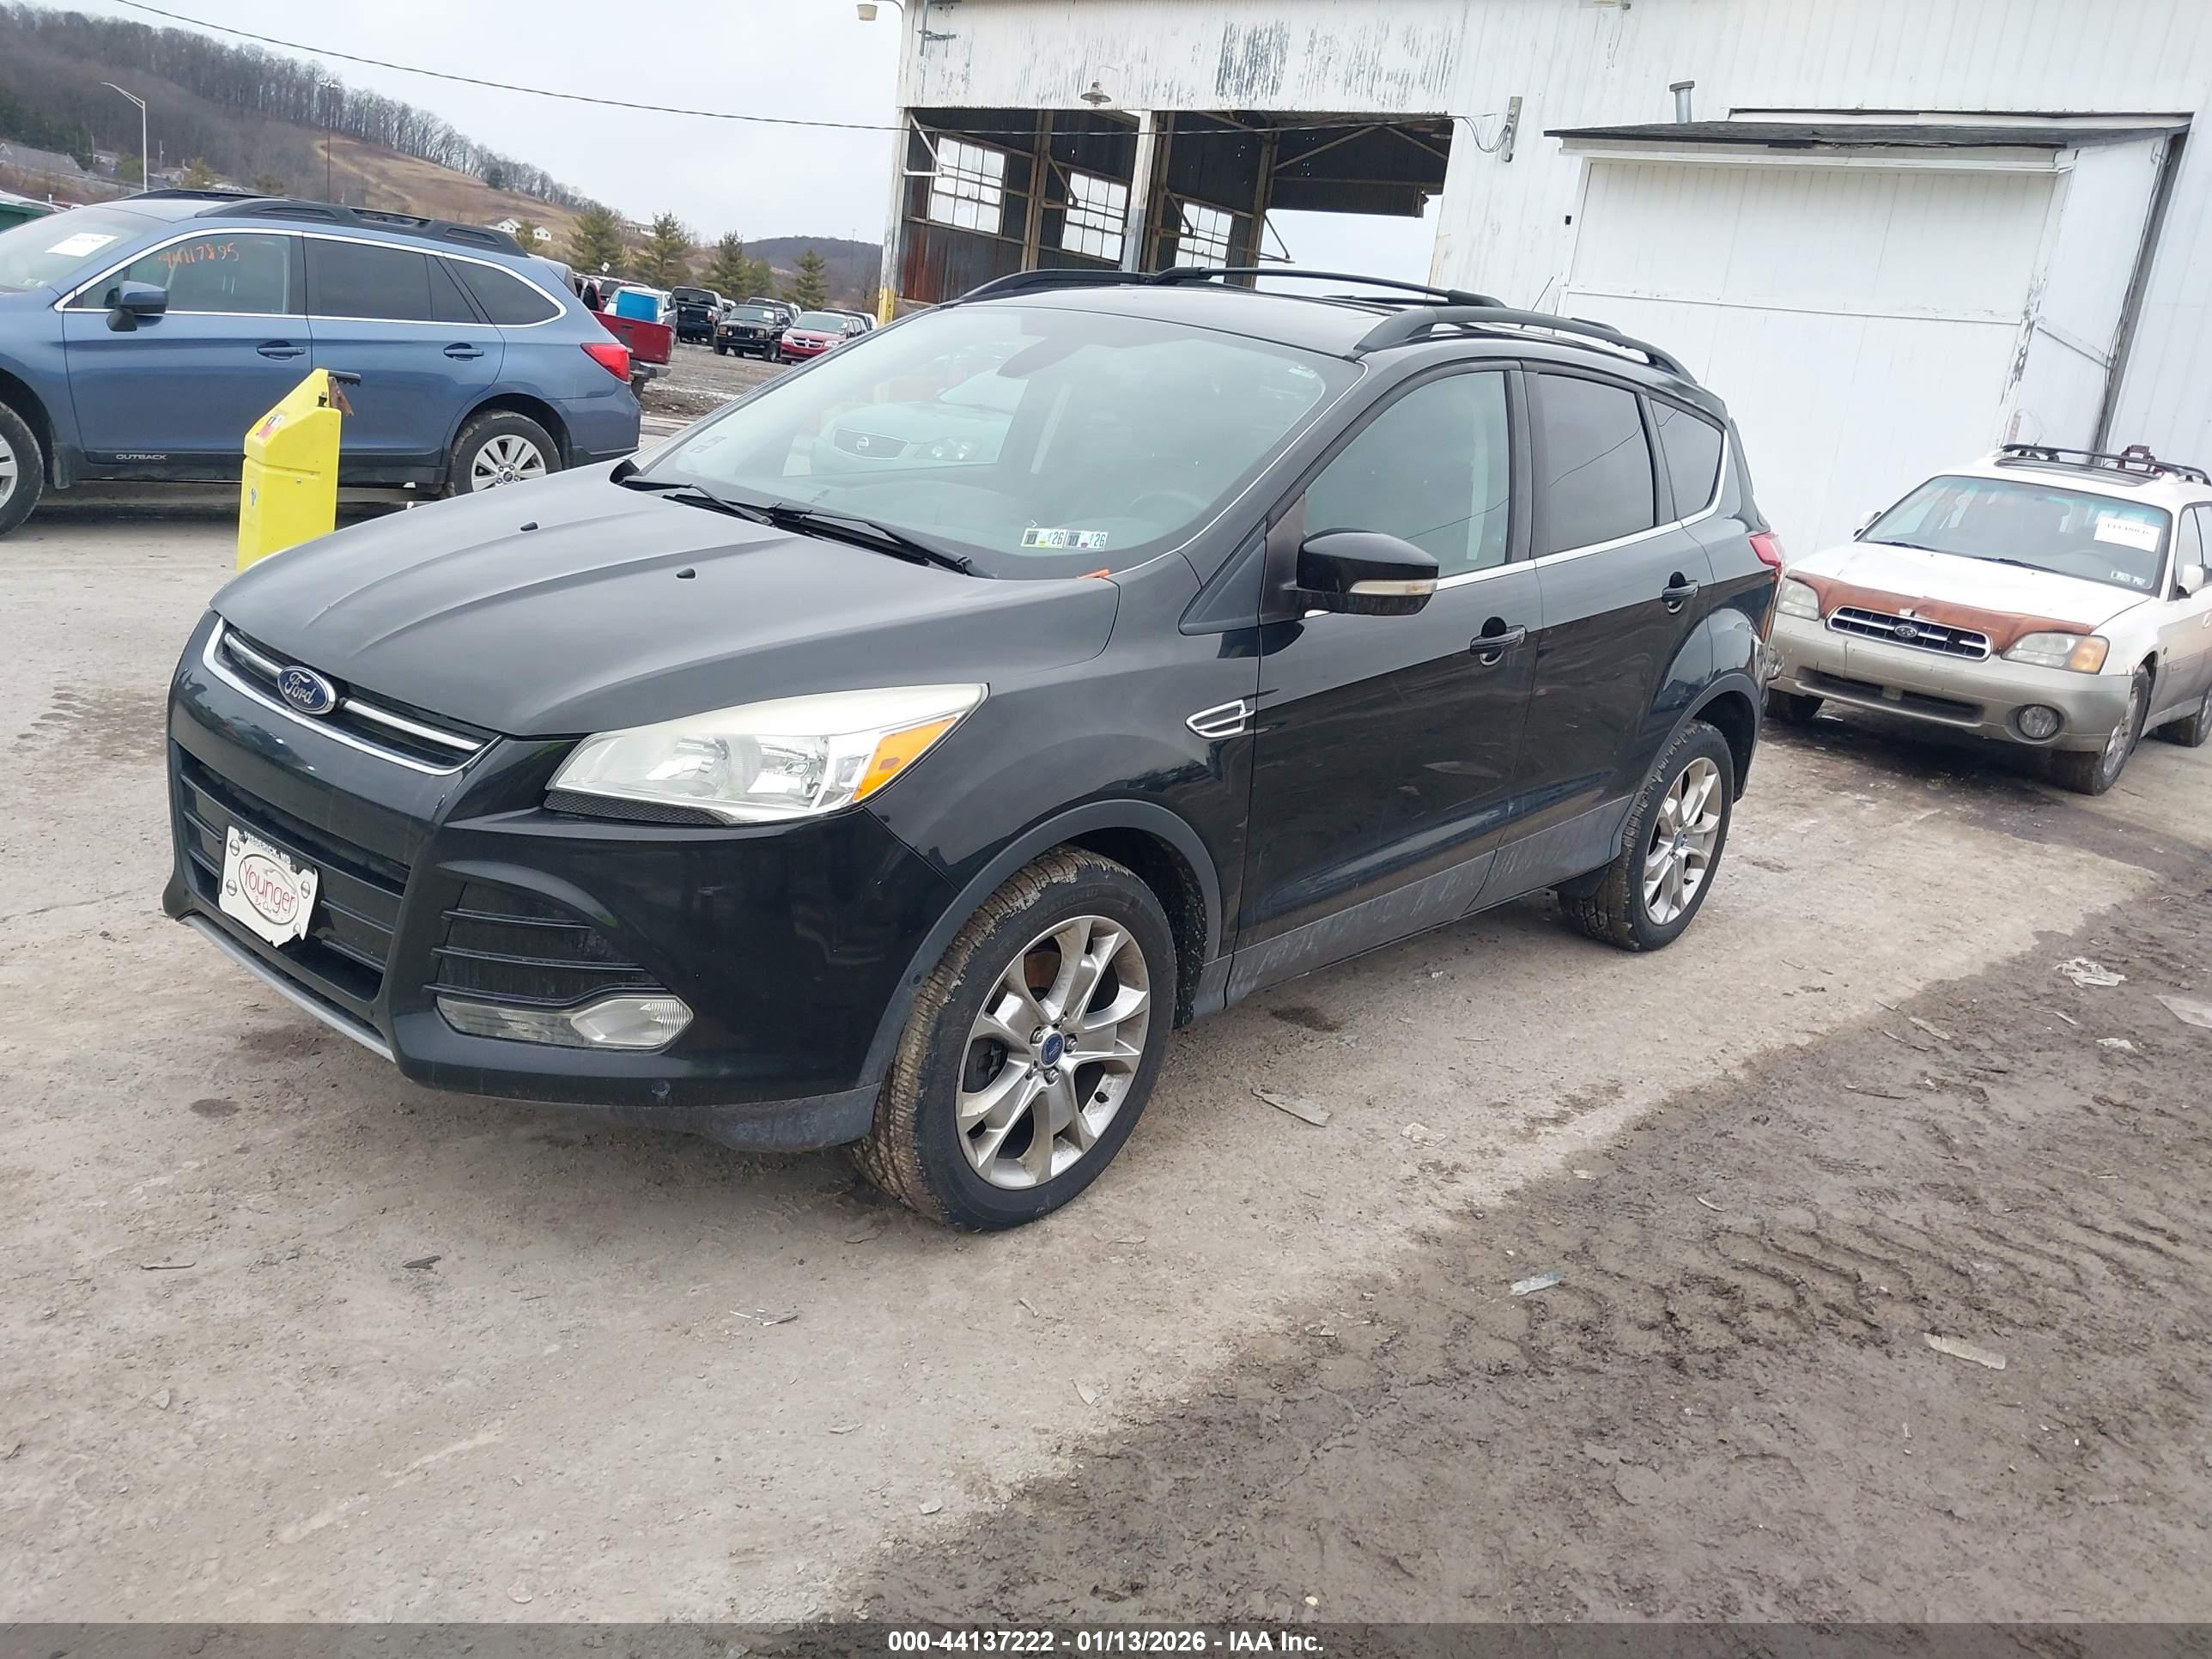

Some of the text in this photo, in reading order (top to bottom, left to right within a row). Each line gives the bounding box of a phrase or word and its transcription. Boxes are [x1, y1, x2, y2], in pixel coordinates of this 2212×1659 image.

[1052, 532, 1064, 544] 26
[1094, 533, 1105, 547] 26
[284, 672, 317, 704] Ford
[242, 860, 296, 916] Younger
